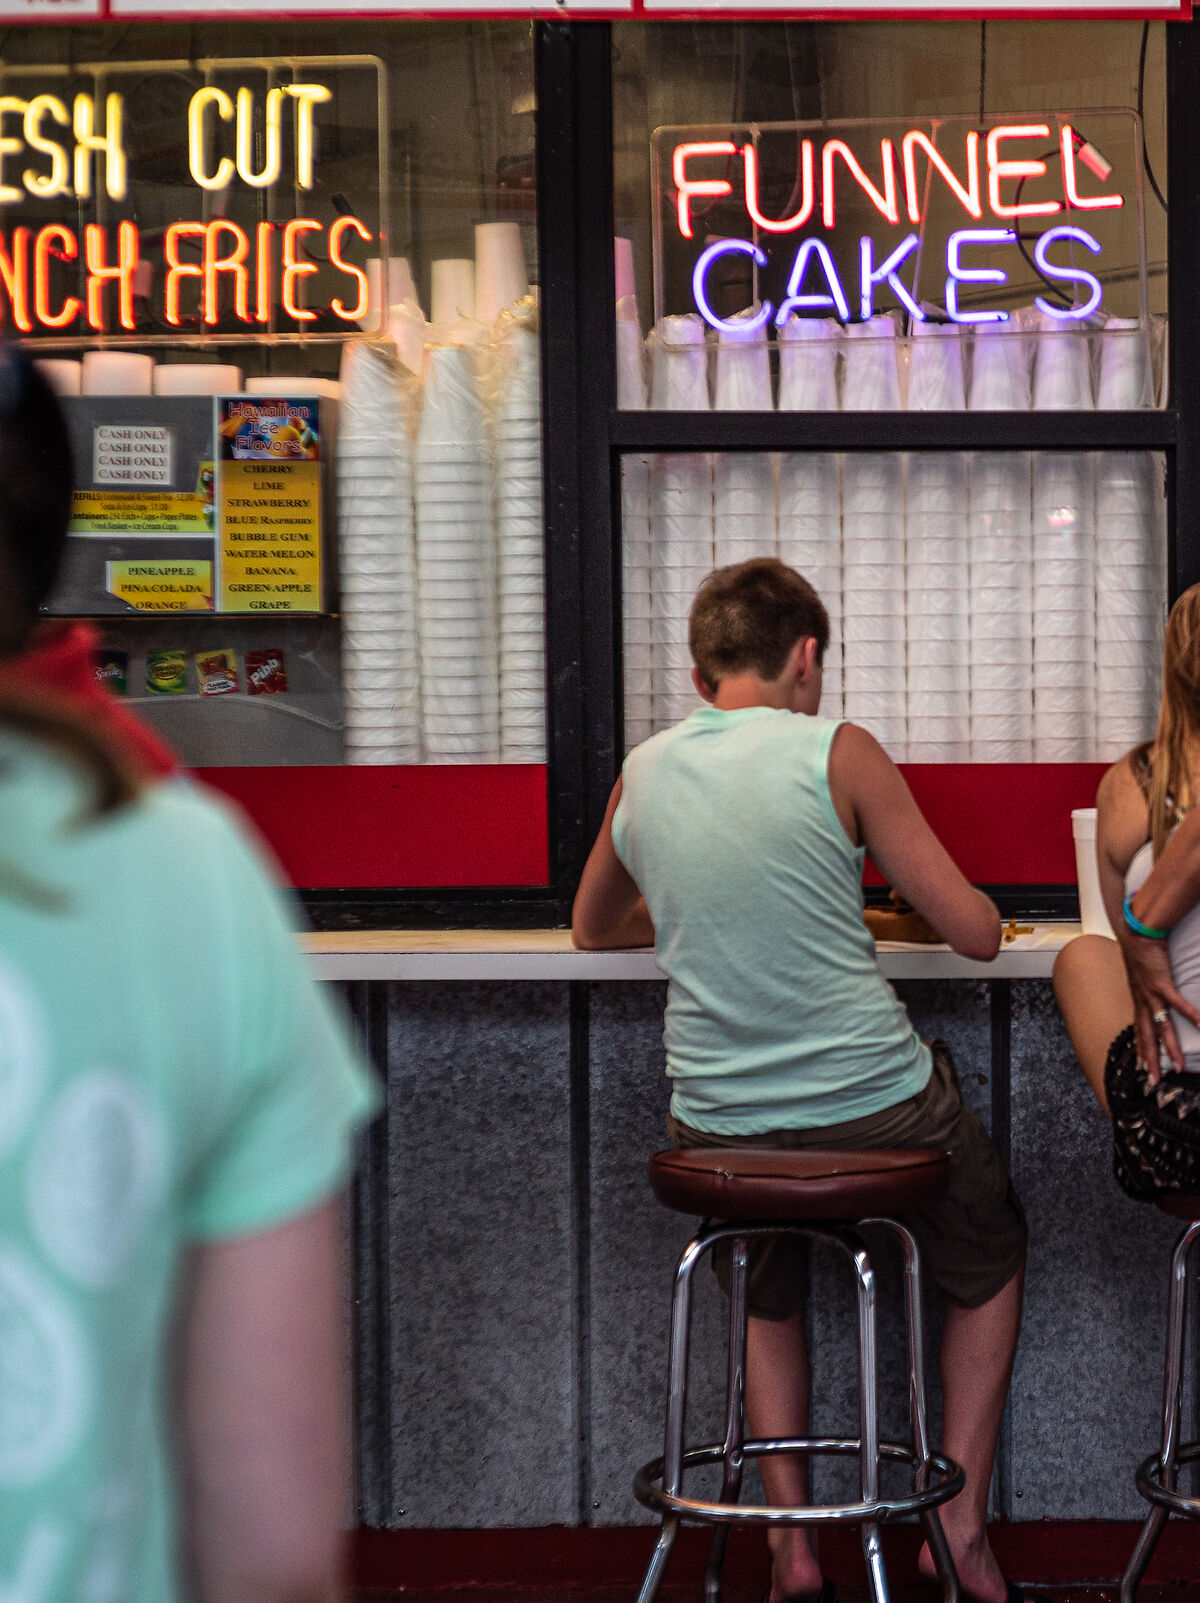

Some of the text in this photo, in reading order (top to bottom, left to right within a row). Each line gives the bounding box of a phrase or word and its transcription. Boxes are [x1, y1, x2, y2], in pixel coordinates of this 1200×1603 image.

[188, 84, 332, 190] CUT
[672, 123, 1124, 238] FUNNEL
[163, 216, 373, 326] FRIES
[692, 226, 1103, 333] CAKES
[228, 402, 309, 418] Hawaiian
[248, 419, 279, 434] Ice
[99, 429, 167, 440] CASH ONLY
[99, 442, 167, 453] CASH ONLY
[236, 436, 301, 452] Flavors
[98, 456, 167, 467] CASH ONLY
[243, 464, 294, 473] CHERRY
[98, 469, 167, 480] CASH ONLY
[253, 482, 284, 490] LIME
[227, 498, 310, 507] STRAWBERRY
[72, 512, 108, 521] ontainers:
[225, 516, 257, 524] BLUE
[230, 533, 309, 541] BUBBLE GUM
[224, 550, 314, 558] WATER MELON
[128, 567, 194, 576] PINEAPPLE
[245, 567, 296, 575] BANANA
[120, 584, 202, 593] PINA COLADA
[228, 583, 312, 592] GREEN APPLE
[135, 601, 187, 609] ORANGE
[249, 601, 291, 609] GRAPE
[249, 658, 279, 685] Pibb
